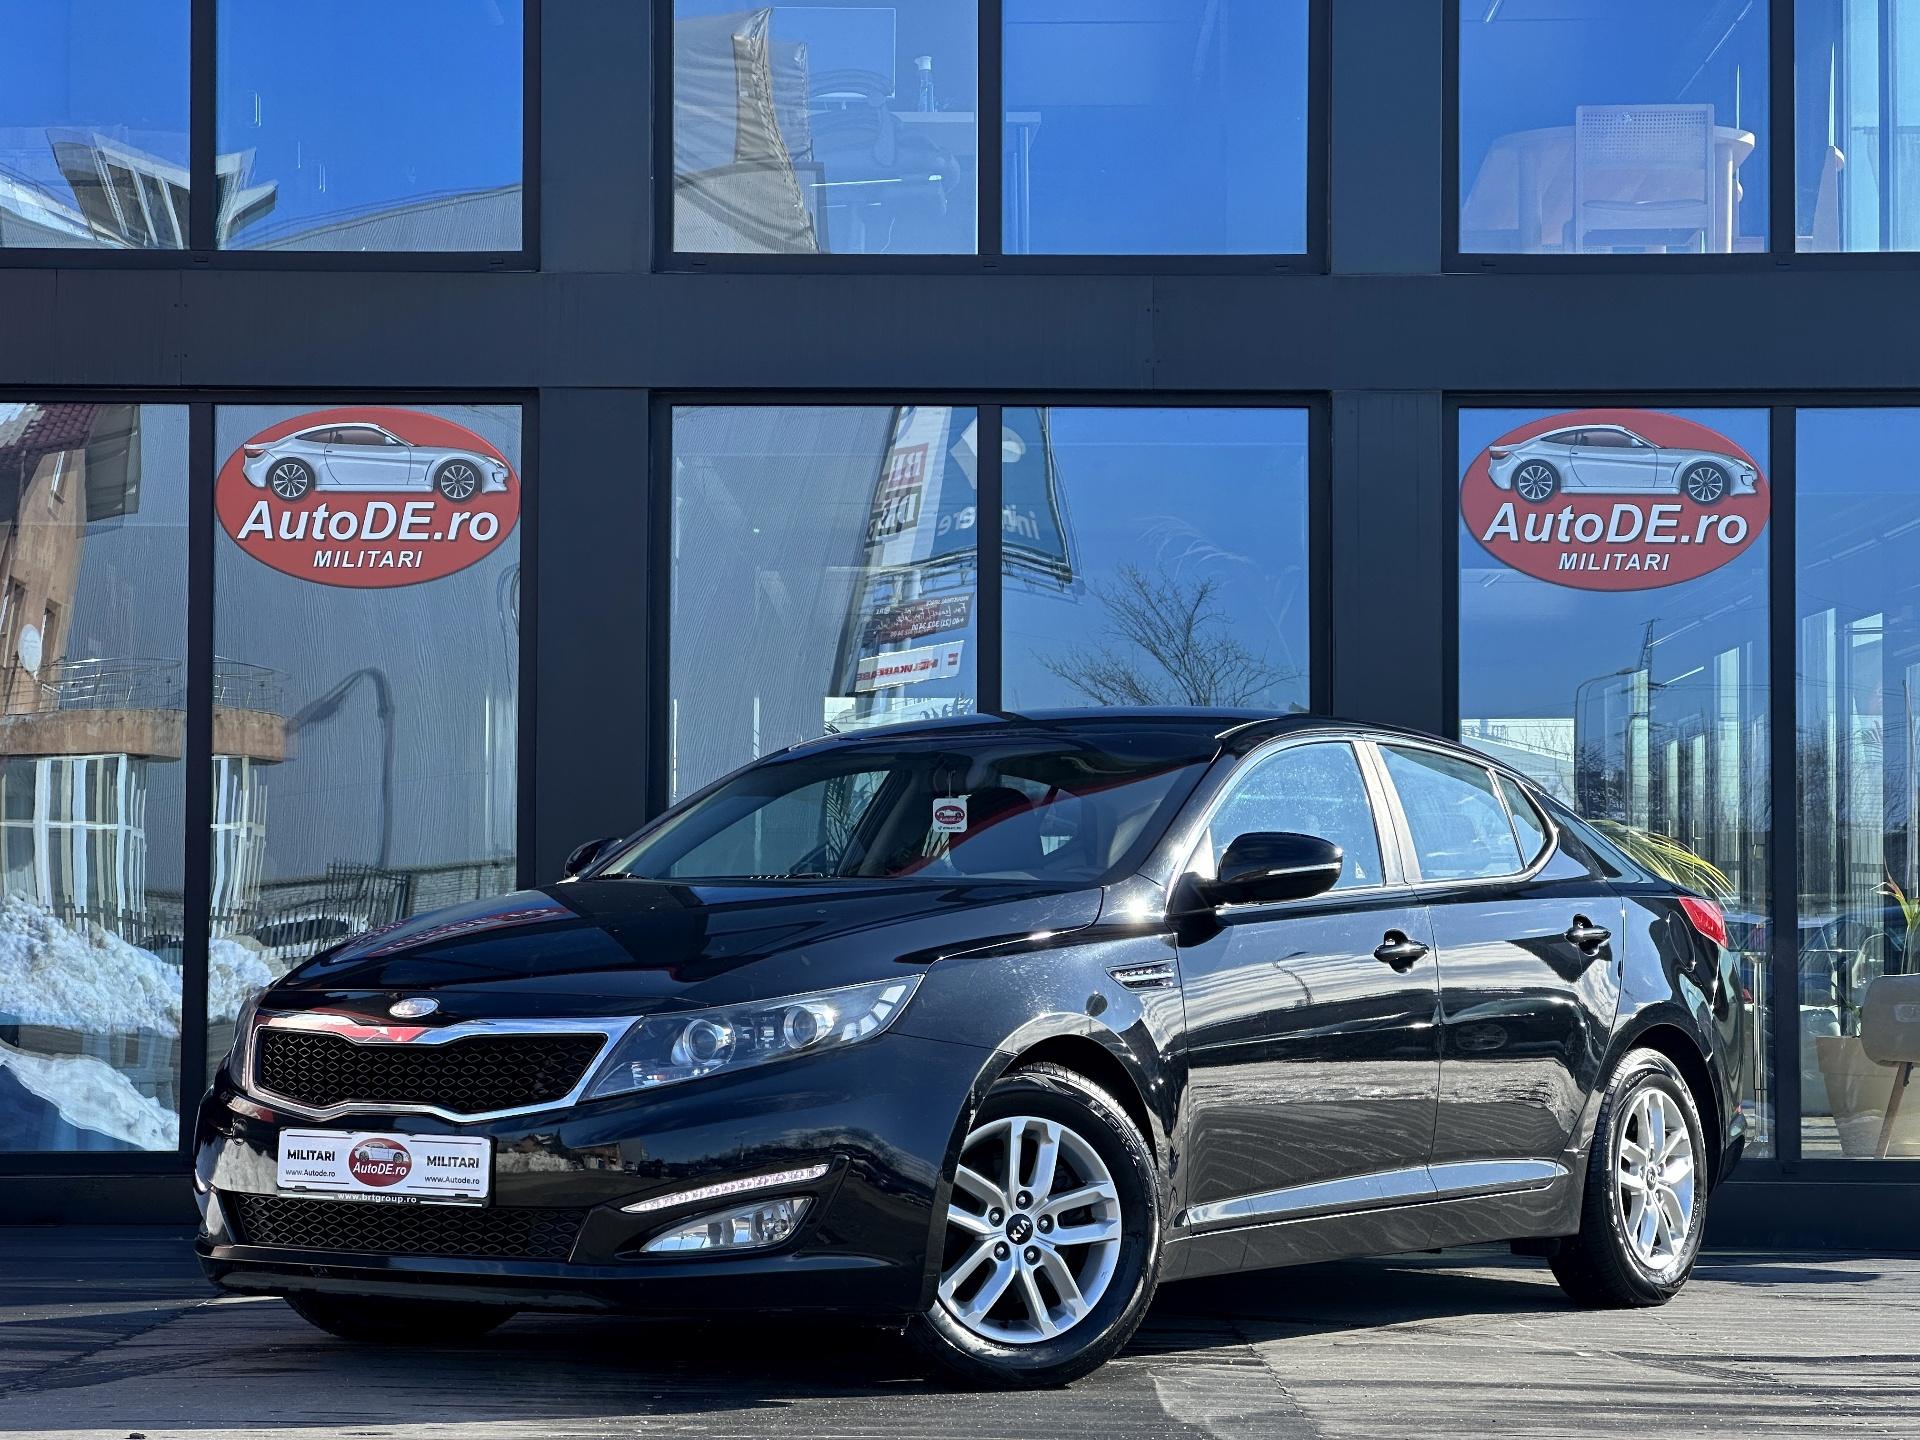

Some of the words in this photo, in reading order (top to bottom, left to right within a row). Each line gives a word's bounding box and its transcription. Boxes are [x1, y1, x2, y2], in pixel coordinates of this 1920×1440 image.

[237, 500, 500, 542] AutoDE.ro
[1482, 502, 1749, 544] AutoDE.ro
[313, 550, 423, 568] MILITARI
[1558, 553, 1670, 572] MILITARI
[287, 1149, 336, 1162] MILITARI
[426, 1155, 480, 1169] MILITARI
[286, 1168, 336, 1178] www.Autode.ro
[353, 1162, 407, 1177] AutoDE.ro
[424, 1175, 480, 1185] www.Autode.ro
[337, 1191, 417, 1204] www.brtgroup.ro
[1010, 1219, 1030, 1241] KIA
